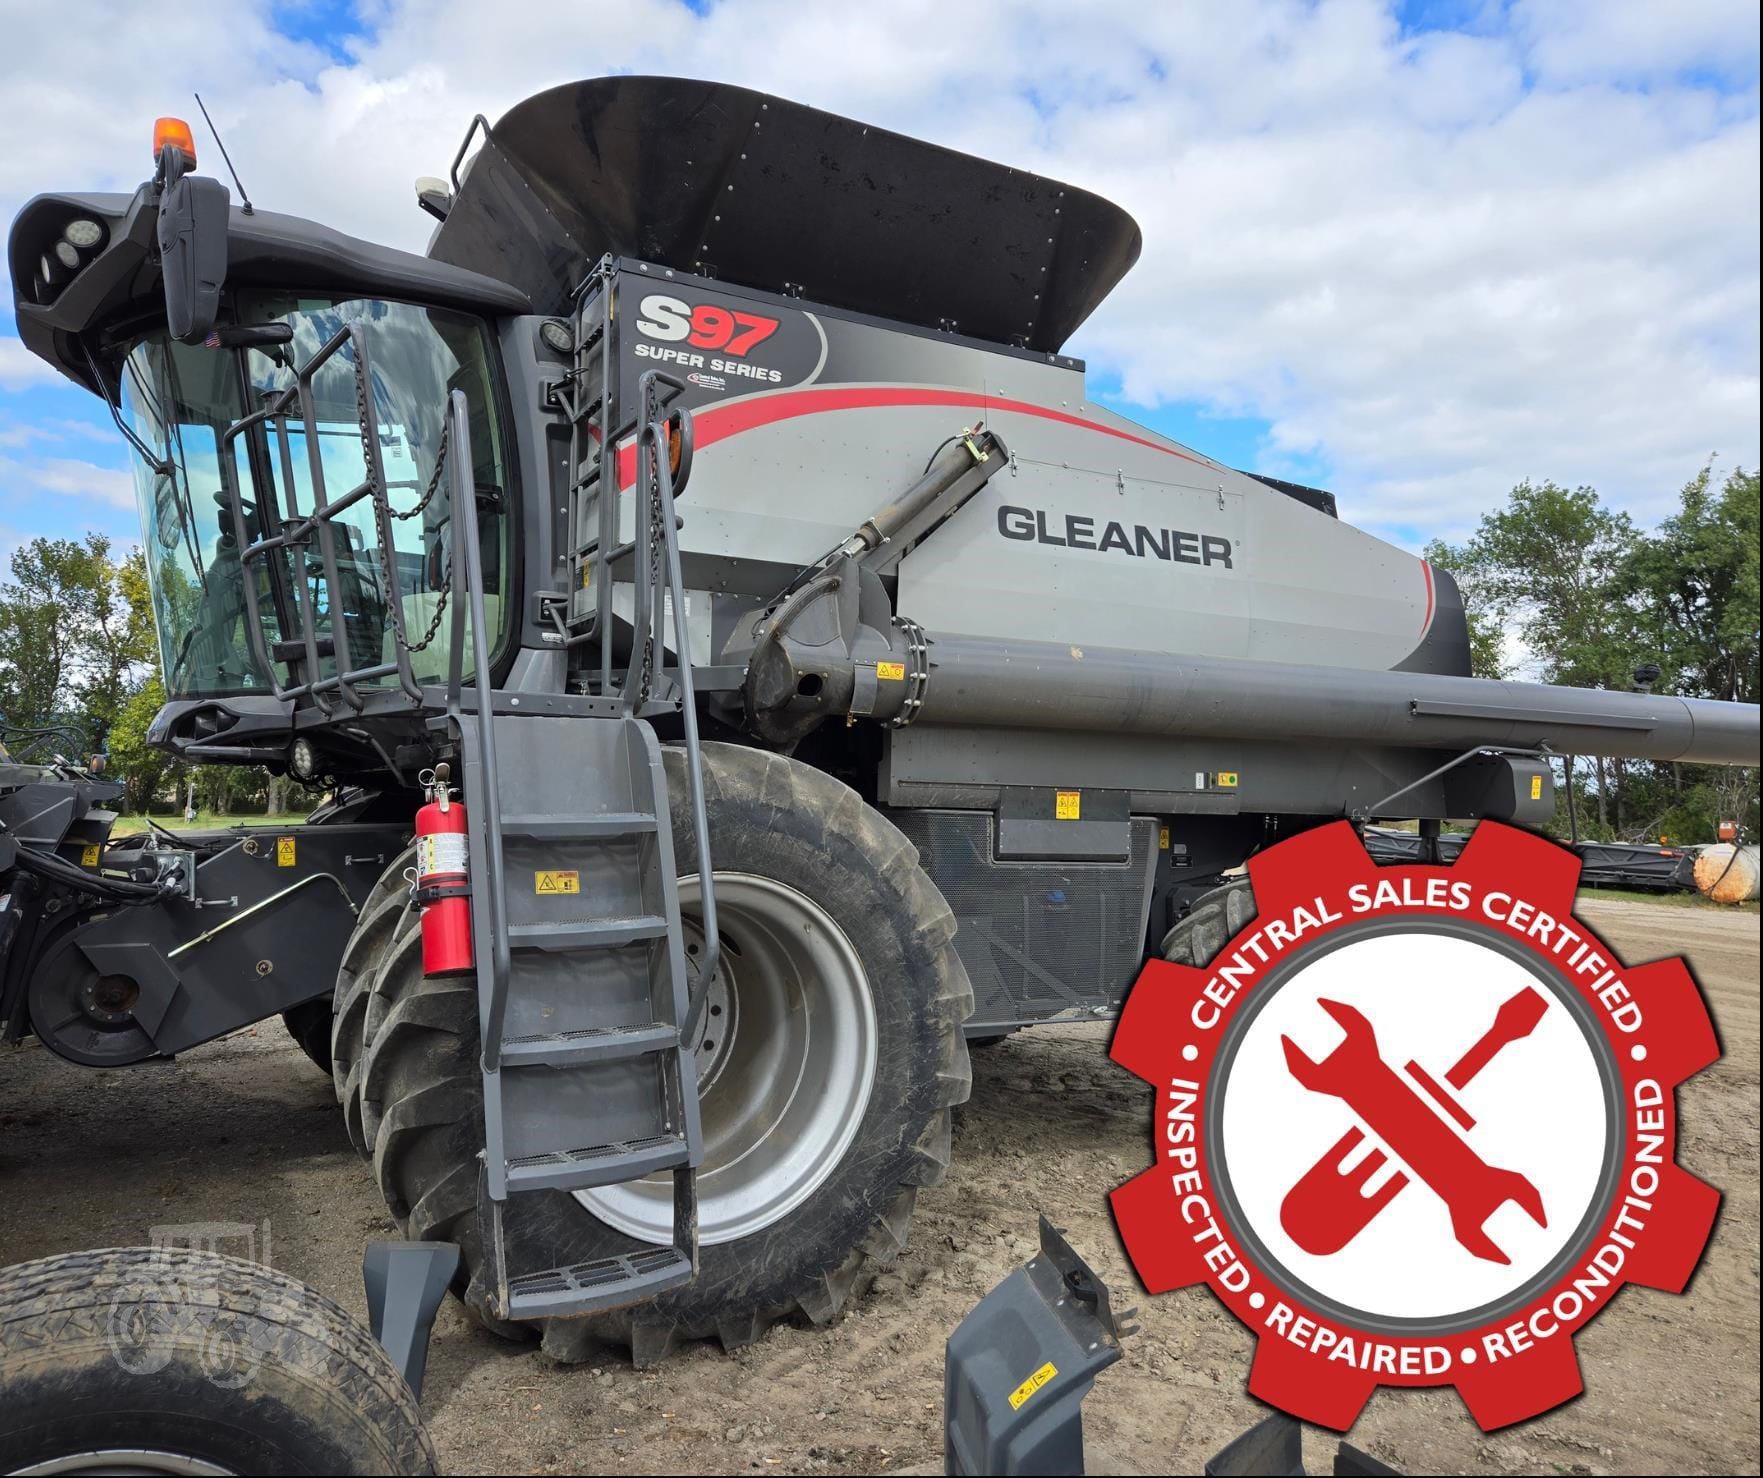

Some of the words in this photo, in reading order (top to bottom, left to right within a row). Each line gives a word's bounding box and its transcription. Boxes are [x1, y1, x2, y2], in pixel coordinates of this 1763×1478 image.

[636, 295, 780, 357] S97
[634, 344, 704, 368] SUPER
[710, 358, 783, 383] SERIES
[997, 505, 1233, 569] GLEANER
